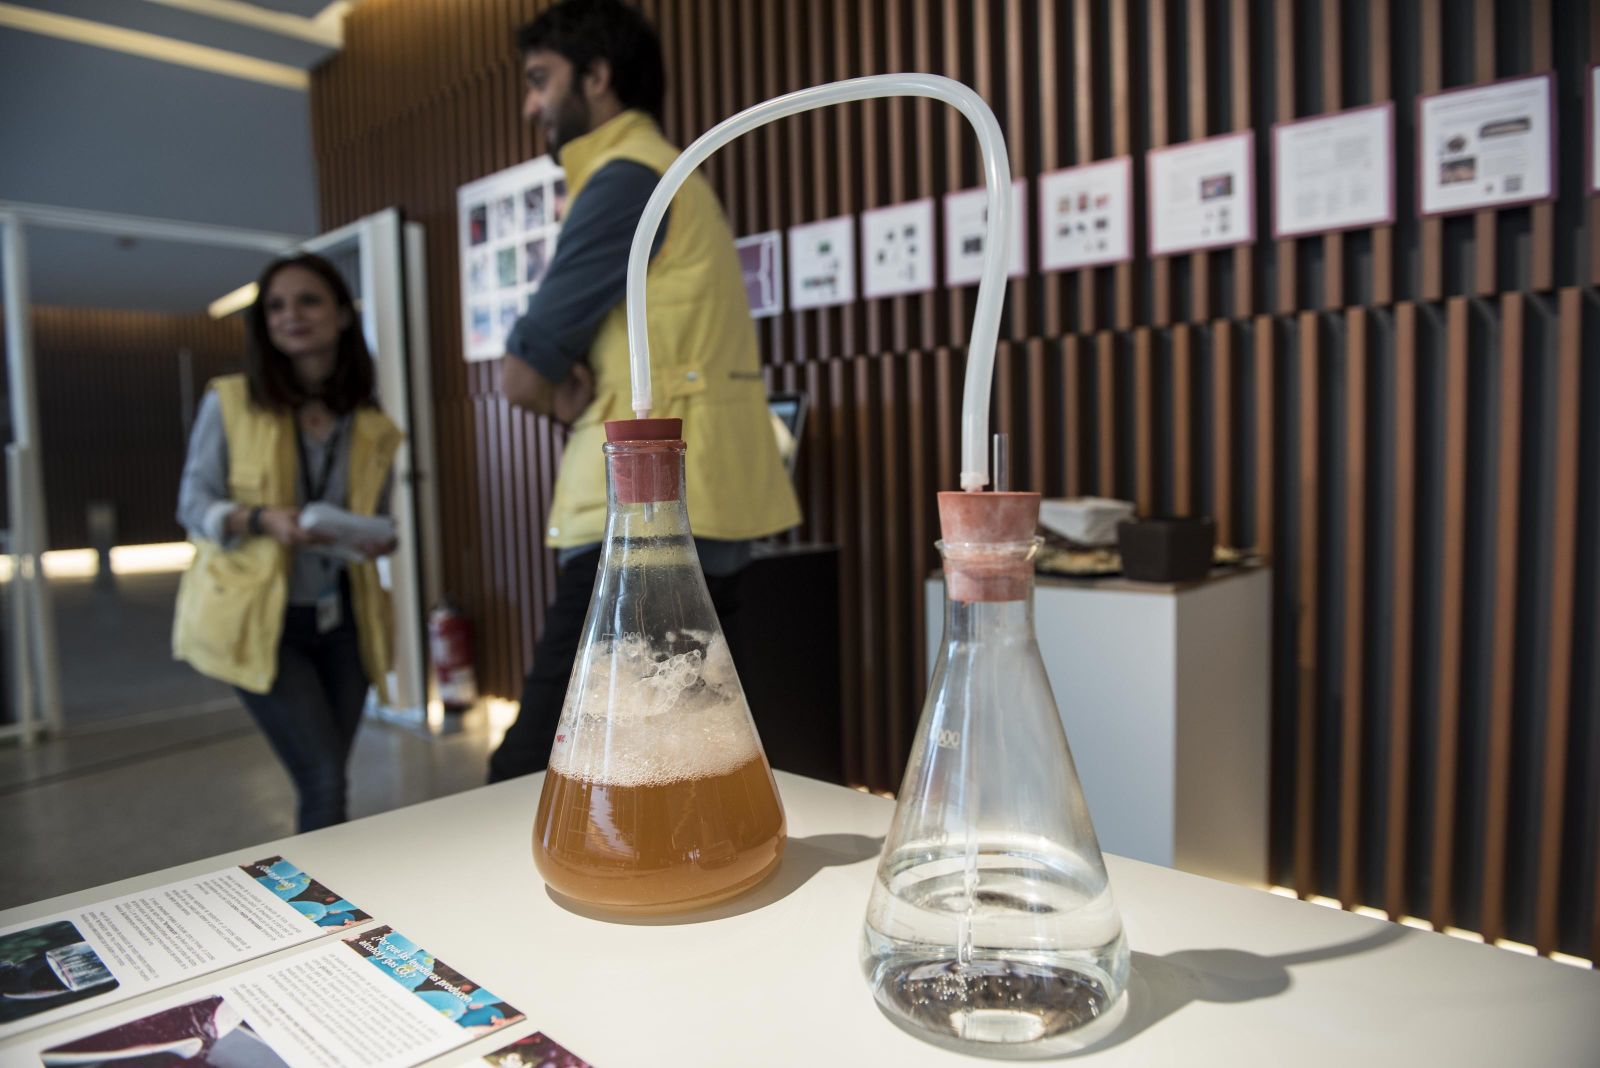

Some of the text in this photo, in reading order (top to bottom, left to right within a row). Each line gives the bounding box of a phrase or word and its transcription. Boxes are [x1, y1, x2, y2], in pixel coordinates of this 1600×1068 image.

[358, 940, 384, 957] alcohol
[407, 959, 441, 981] levaduras
[435, 980, 473, 1002] producen
